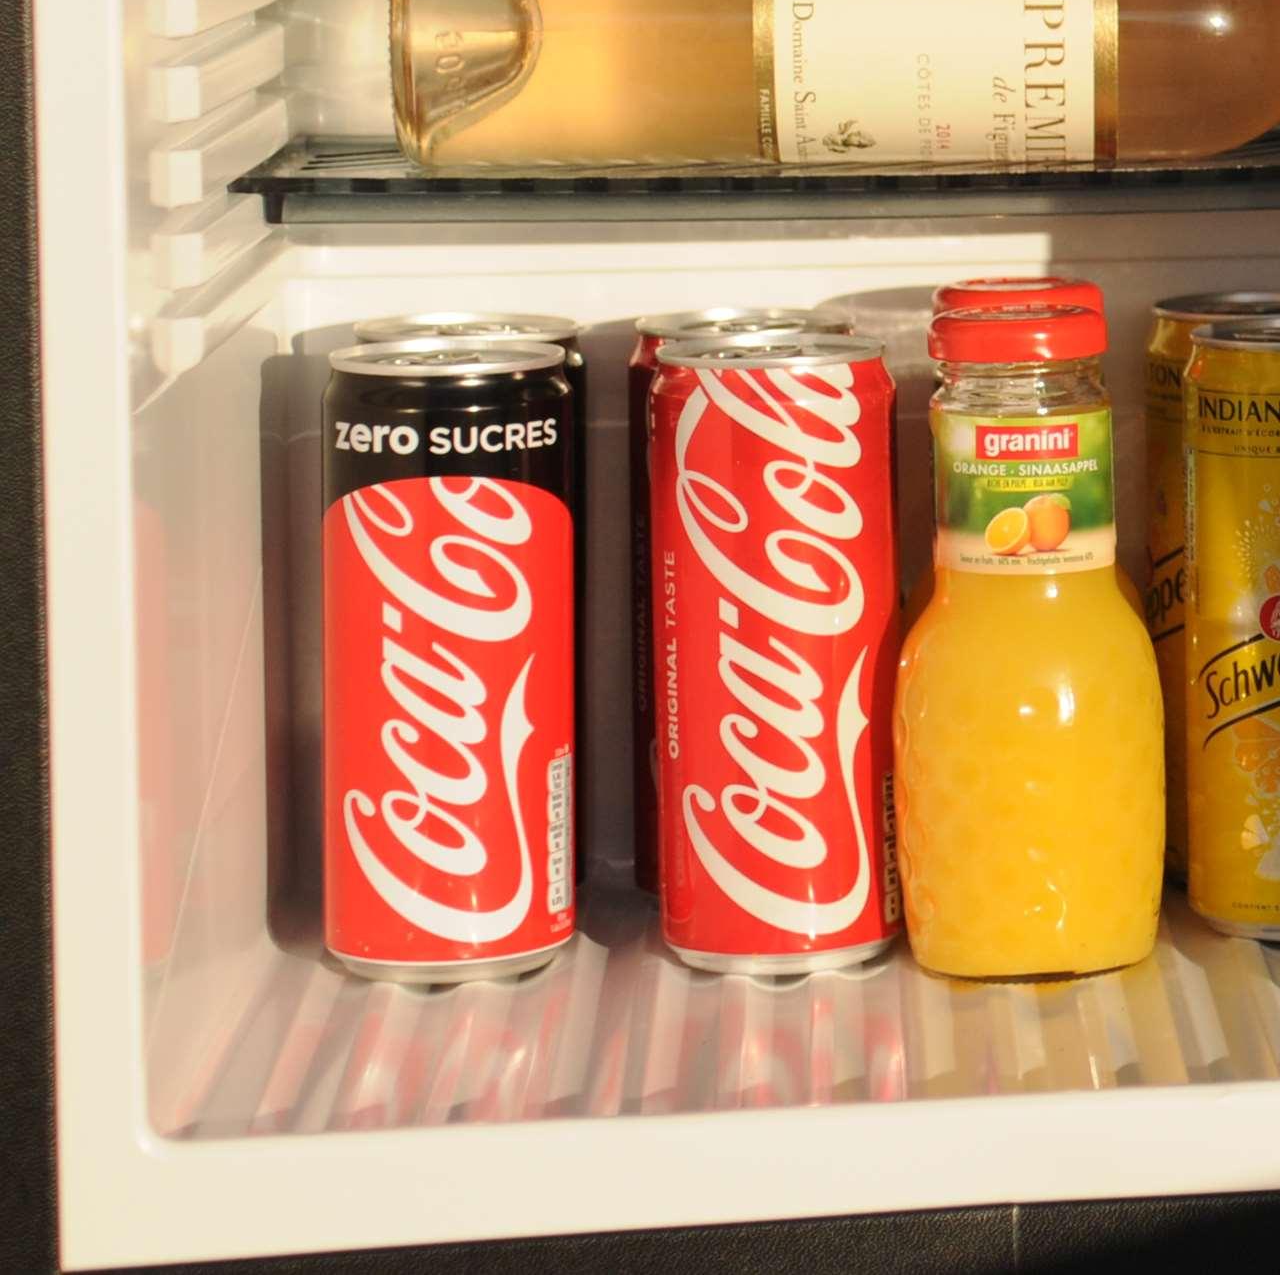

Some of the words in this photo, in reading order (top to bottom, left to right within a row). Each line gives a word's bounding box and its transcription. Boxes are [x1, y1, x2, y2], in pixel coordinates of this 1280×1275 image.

[791, 1, 815, 86] Domaine
[758, 88, 772, 136] FAMILLE
[792, 91, 816, 135] Saint
[335, 421, 419, 455] zero
[429, 418, 558, 455] SUCRES
[953, 462, 1007, 476] ORANGE
[1018, 458, 1098, 475] SINAASAPPEL
[984, 428, 1070, 457] granini
[634, 512, 646, 584] TASTE
[663, 550, 677, 630] TASTE
[636, 597, 648, 712] ORIGINAL
[675, 363, 870, 935] Coca-Cola
[667, 637, 680, 760] ORIGINAL
